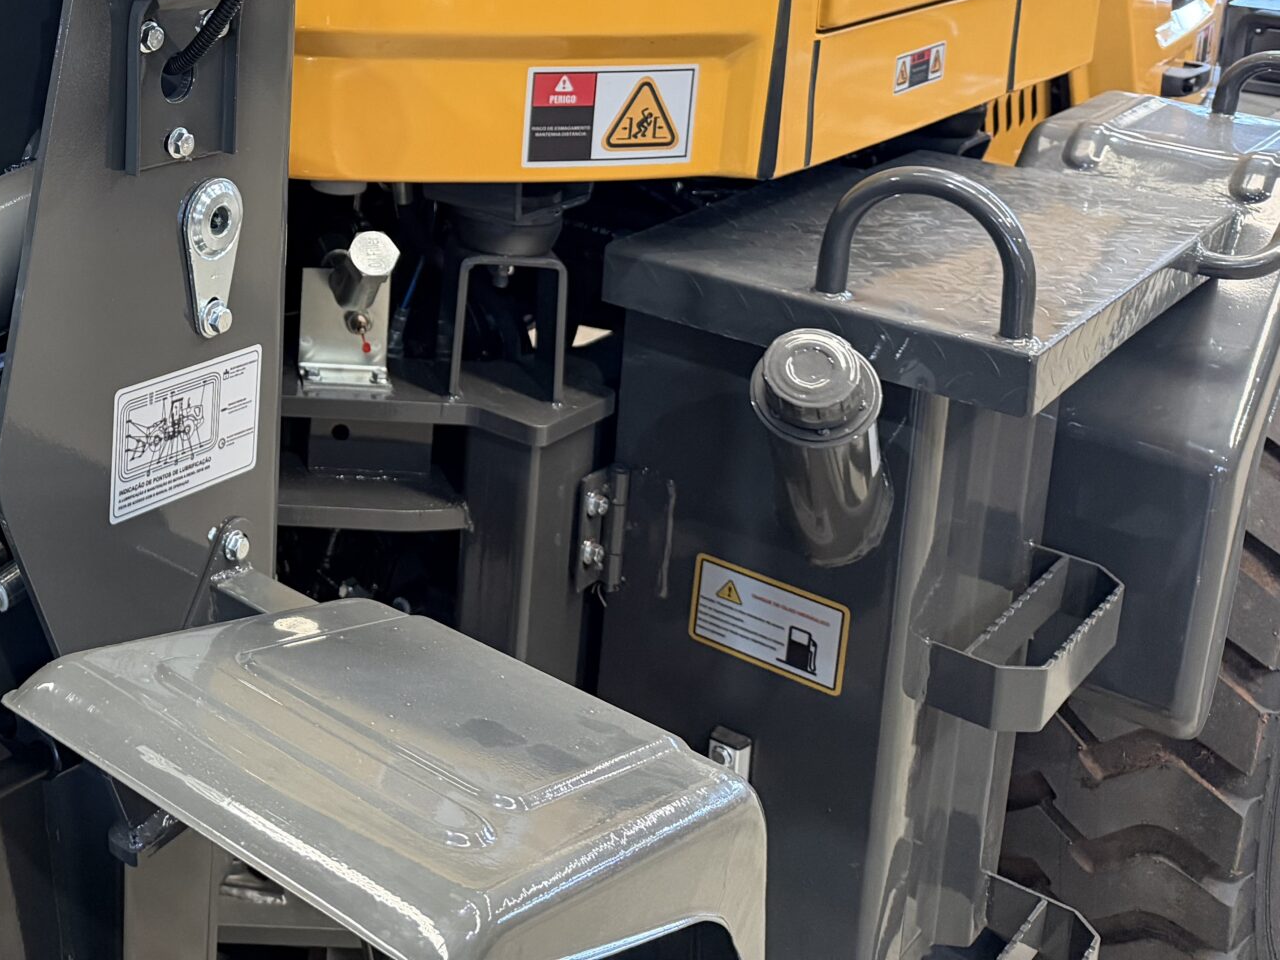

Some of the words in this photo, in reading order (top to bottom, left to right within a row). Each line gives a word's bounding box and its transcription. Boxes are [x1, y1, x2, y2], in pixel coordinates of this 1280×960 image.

[549, 95, 577, 104] PERIGO
[119, 481, 146, 496] INDICAÇÃO
[145, 479, 153, 488] DE
[153, 471, 171, 484] PONTOS
[172, 468, 179, 476] DE
[179, 456, 212, 473] LUBRIFICAÇÃO
